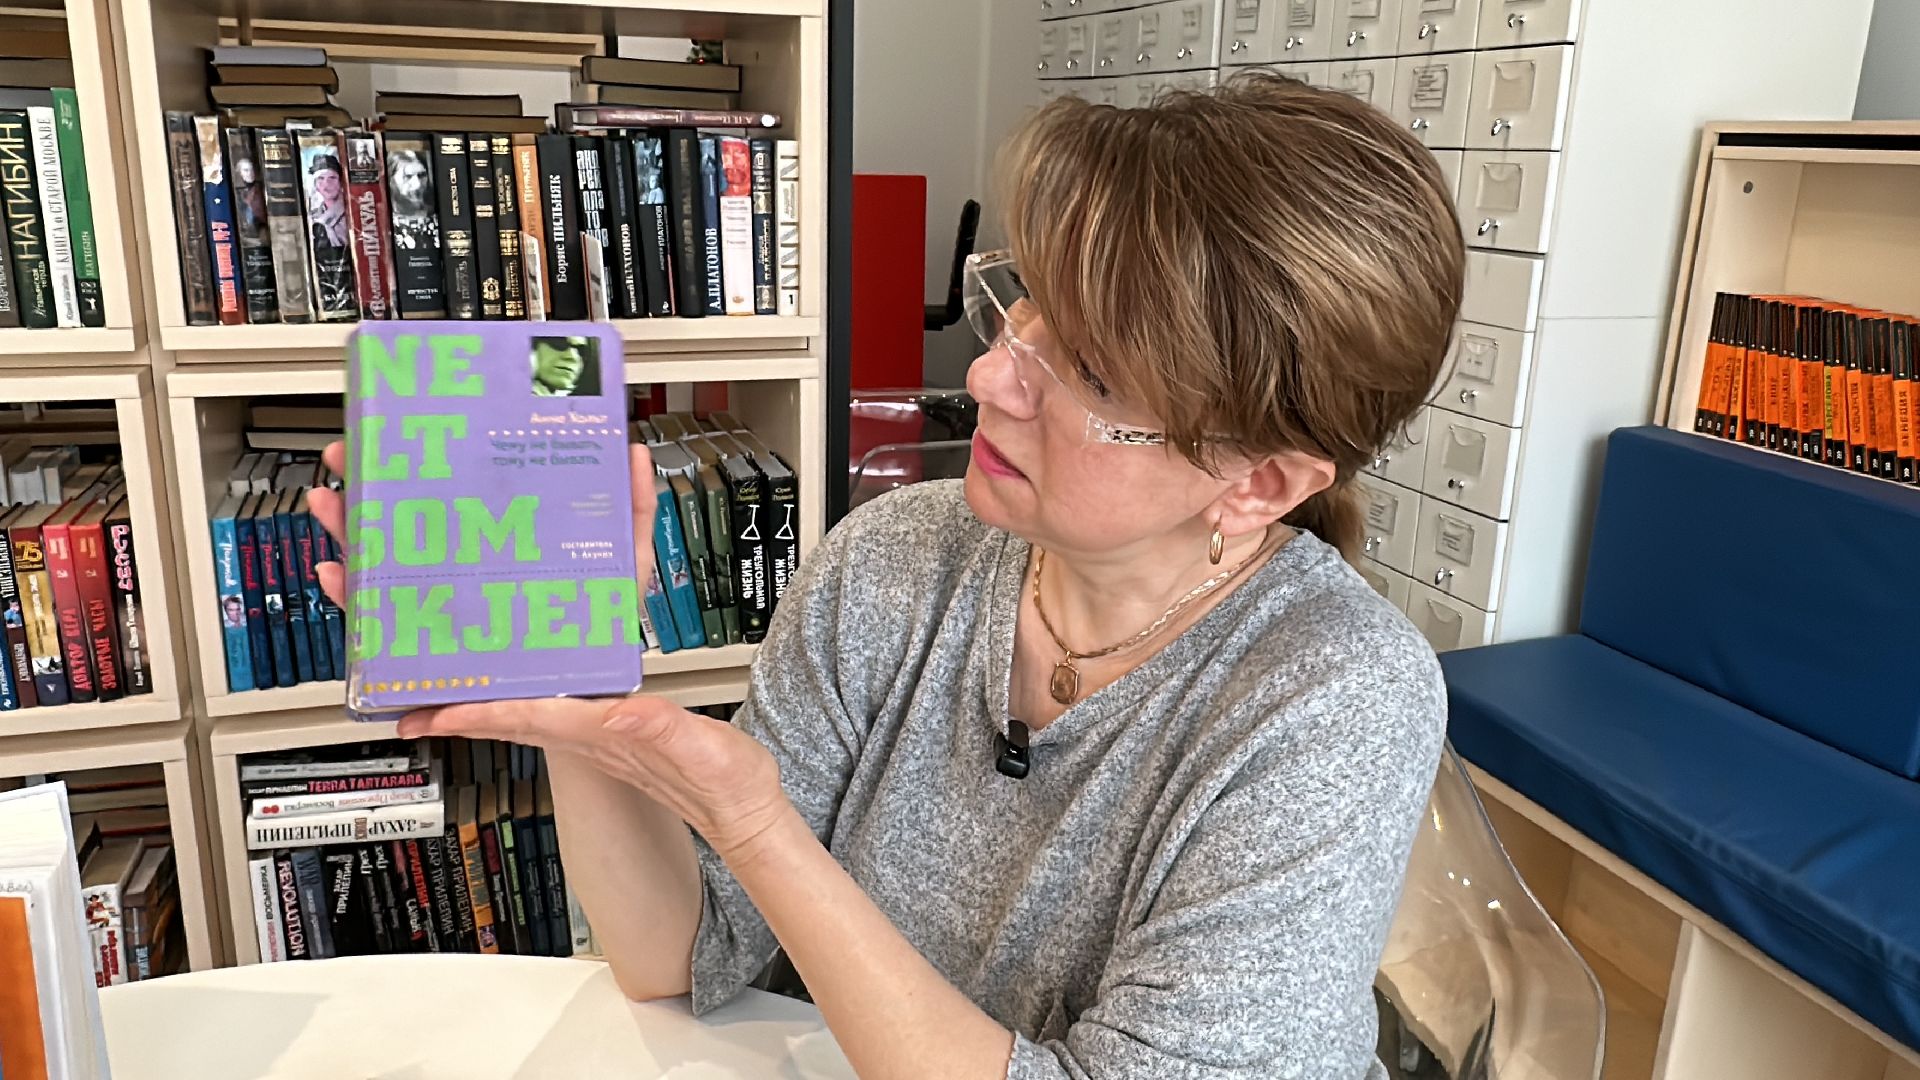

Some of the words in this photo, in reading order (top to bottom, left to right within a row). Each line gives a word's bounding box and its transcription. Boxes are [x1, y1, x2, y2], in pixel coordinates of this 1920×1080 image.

[37, 117, 56, 166] МОСКВЕ
[0, 122, 42, 260] НАГИБИН
[44, 169, 62, 214] СТАРОЙ
[549, 174, 565, 242] ПИЛЬНЯК
[55, 225, 71, 264] КНИГА
[359, 190, 381, 257] ПИКУЛЬ
[655, 204, 666, 247] ПЛАТОНОВ
[555, 242, 568, 284] Борис
[620, 223, 635, 285] ПЛАТОНОВ
[788, 294, 794, 305] 1
[357, 333, 485, 398] NE
[1898, 389, 1911, 449] ВЕНЕЦИЯ
[357, 414, 468, 482] LT
[529, 441, 547, 449] не
[529, 456, 547, 465] не
[15, 541, 43, 563] 75
[348, 495, 541, 573] SOM
[582, 550, 613, 560] Акунин
[741, 558, 754, 600] ЖИЗНЬ
[753, 543, 766, 610] ТРЕУГОЛЬНАЯ
[787, 543, 796, 582] ТРЕУГО
[62, 607, 81, 638] ВЕРА
[90, 599, 106, 633] ЧАСЫ
[349, 577, 640, 662] SKJER
[68, 642, 92, 691] ДОКТОР
[95, 637, 117, 690] ЗОЛОТЫЕ
[307, 779, 347, 794] TERRA
[349, 773, 424, 791] TARTARARA
[256, 822, 352, 843] ПРИЛЕПИН
[368, 818, 417, 834] ЗАХАР
[259, 865, 274, 920] ВОСЬМЕРКА
[277, 860, 306, 957] REVOLUTION
[336, 861, 353, 914] ПРИЛЕПИН
[432, 867, 455, 935] ПРИЛЕПИН
[452, 865, 473, 933] ПРИЛЕПИН
